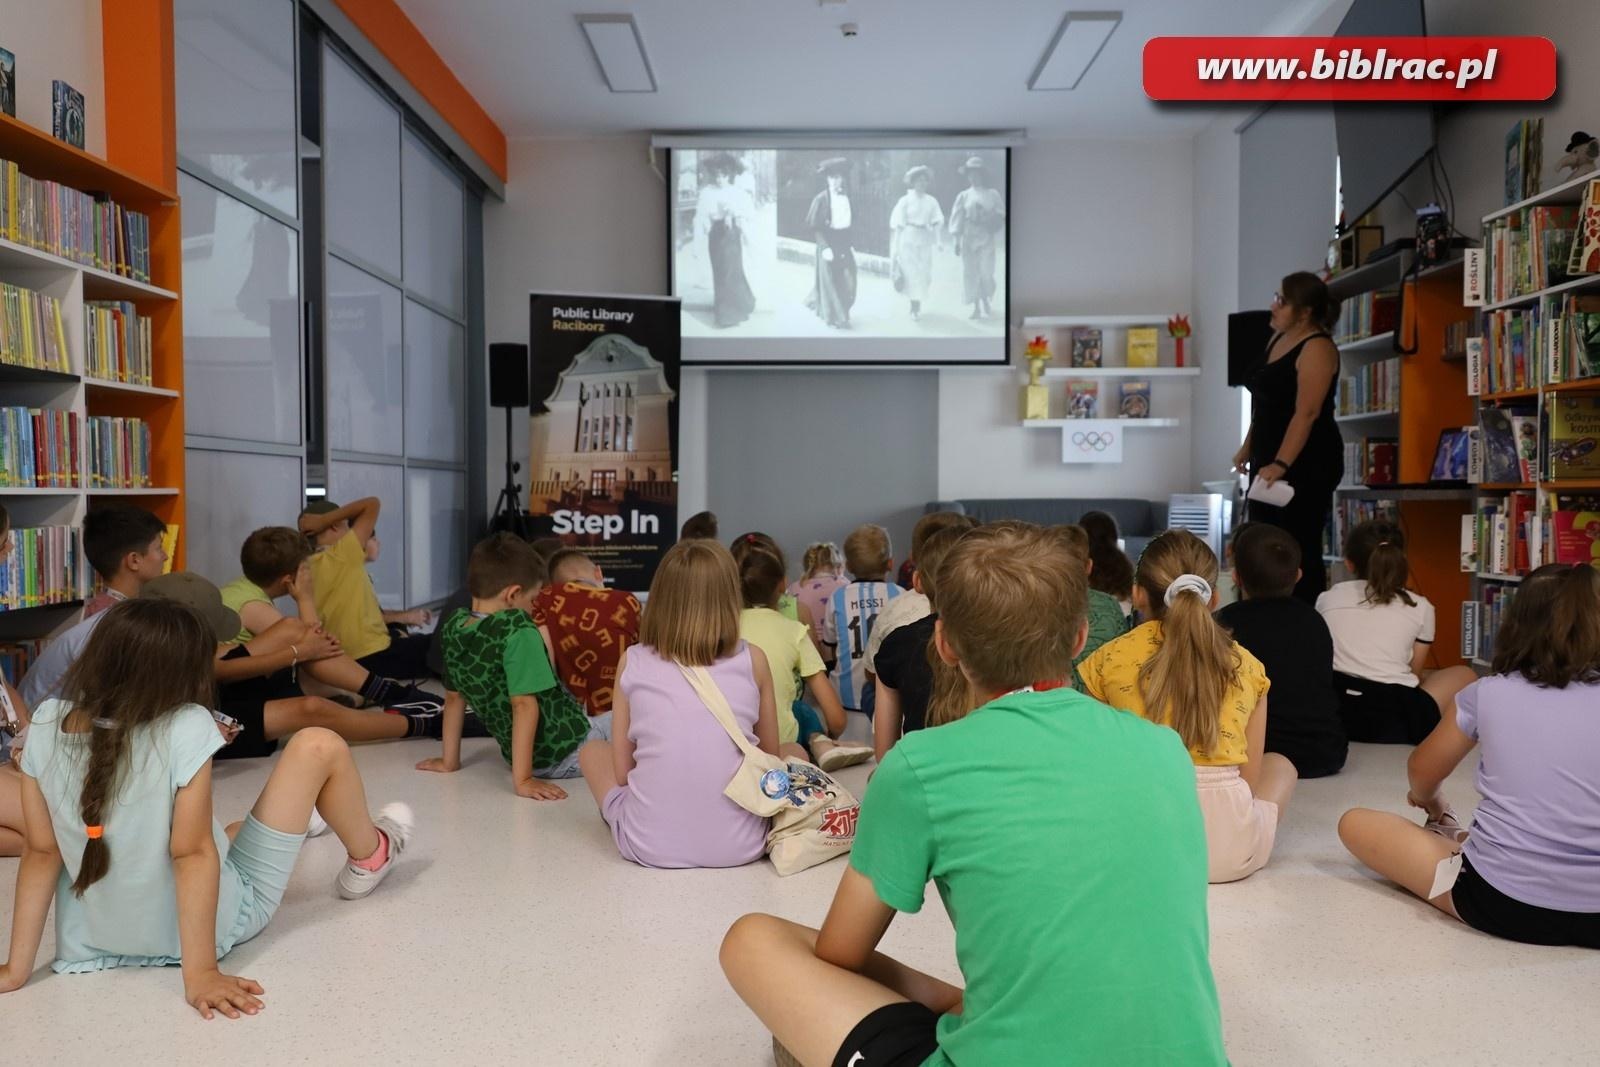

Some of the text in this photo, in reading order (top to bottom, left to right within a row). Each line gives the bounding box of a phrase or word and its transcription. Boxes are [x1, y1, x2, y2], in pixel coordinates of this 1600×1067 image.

[552, 307, 634, 324] Public Library
[552, 509, 659, 540] Step In
[851, 598, 884, 610] MESSI
[1464, 608, 1473, 655] MITOLOGIA
